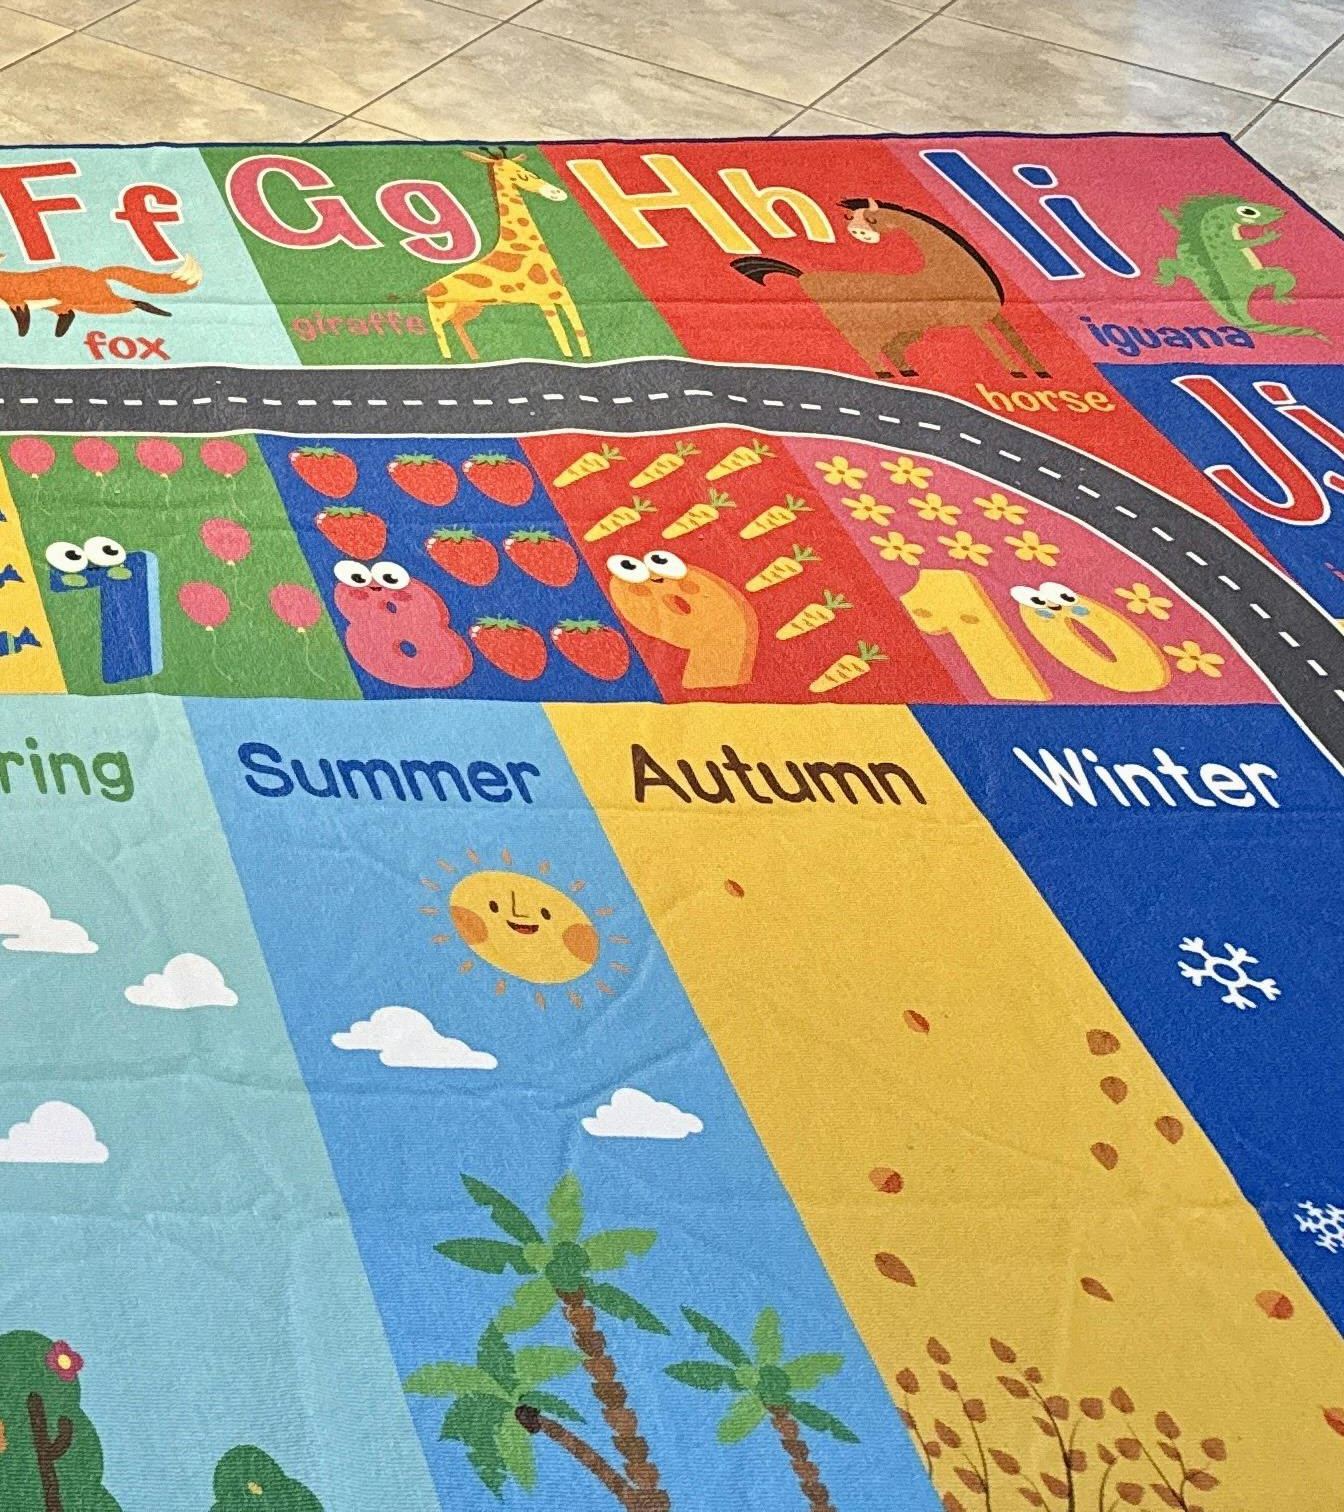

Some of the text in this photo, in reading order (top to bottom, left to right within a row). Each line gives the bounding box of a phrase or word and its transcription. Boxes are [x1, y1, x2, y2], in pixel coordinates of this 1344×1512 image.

[225, 154, 482, 264] Gg
[566, 153, 835, 257] Hh
[919, 149, 1141, 281] Ii
[84, 330, 171, 362] fox
[291, 309, 428, 341] giraffe
[1080, 316, 1256, 354] iguana
[976, 383, 1116, 413] horse
[241, 741, 543, 805] Summer
[631, 743, 927, 809] Autumn
[1013, 747, 1281, 809] Winter
